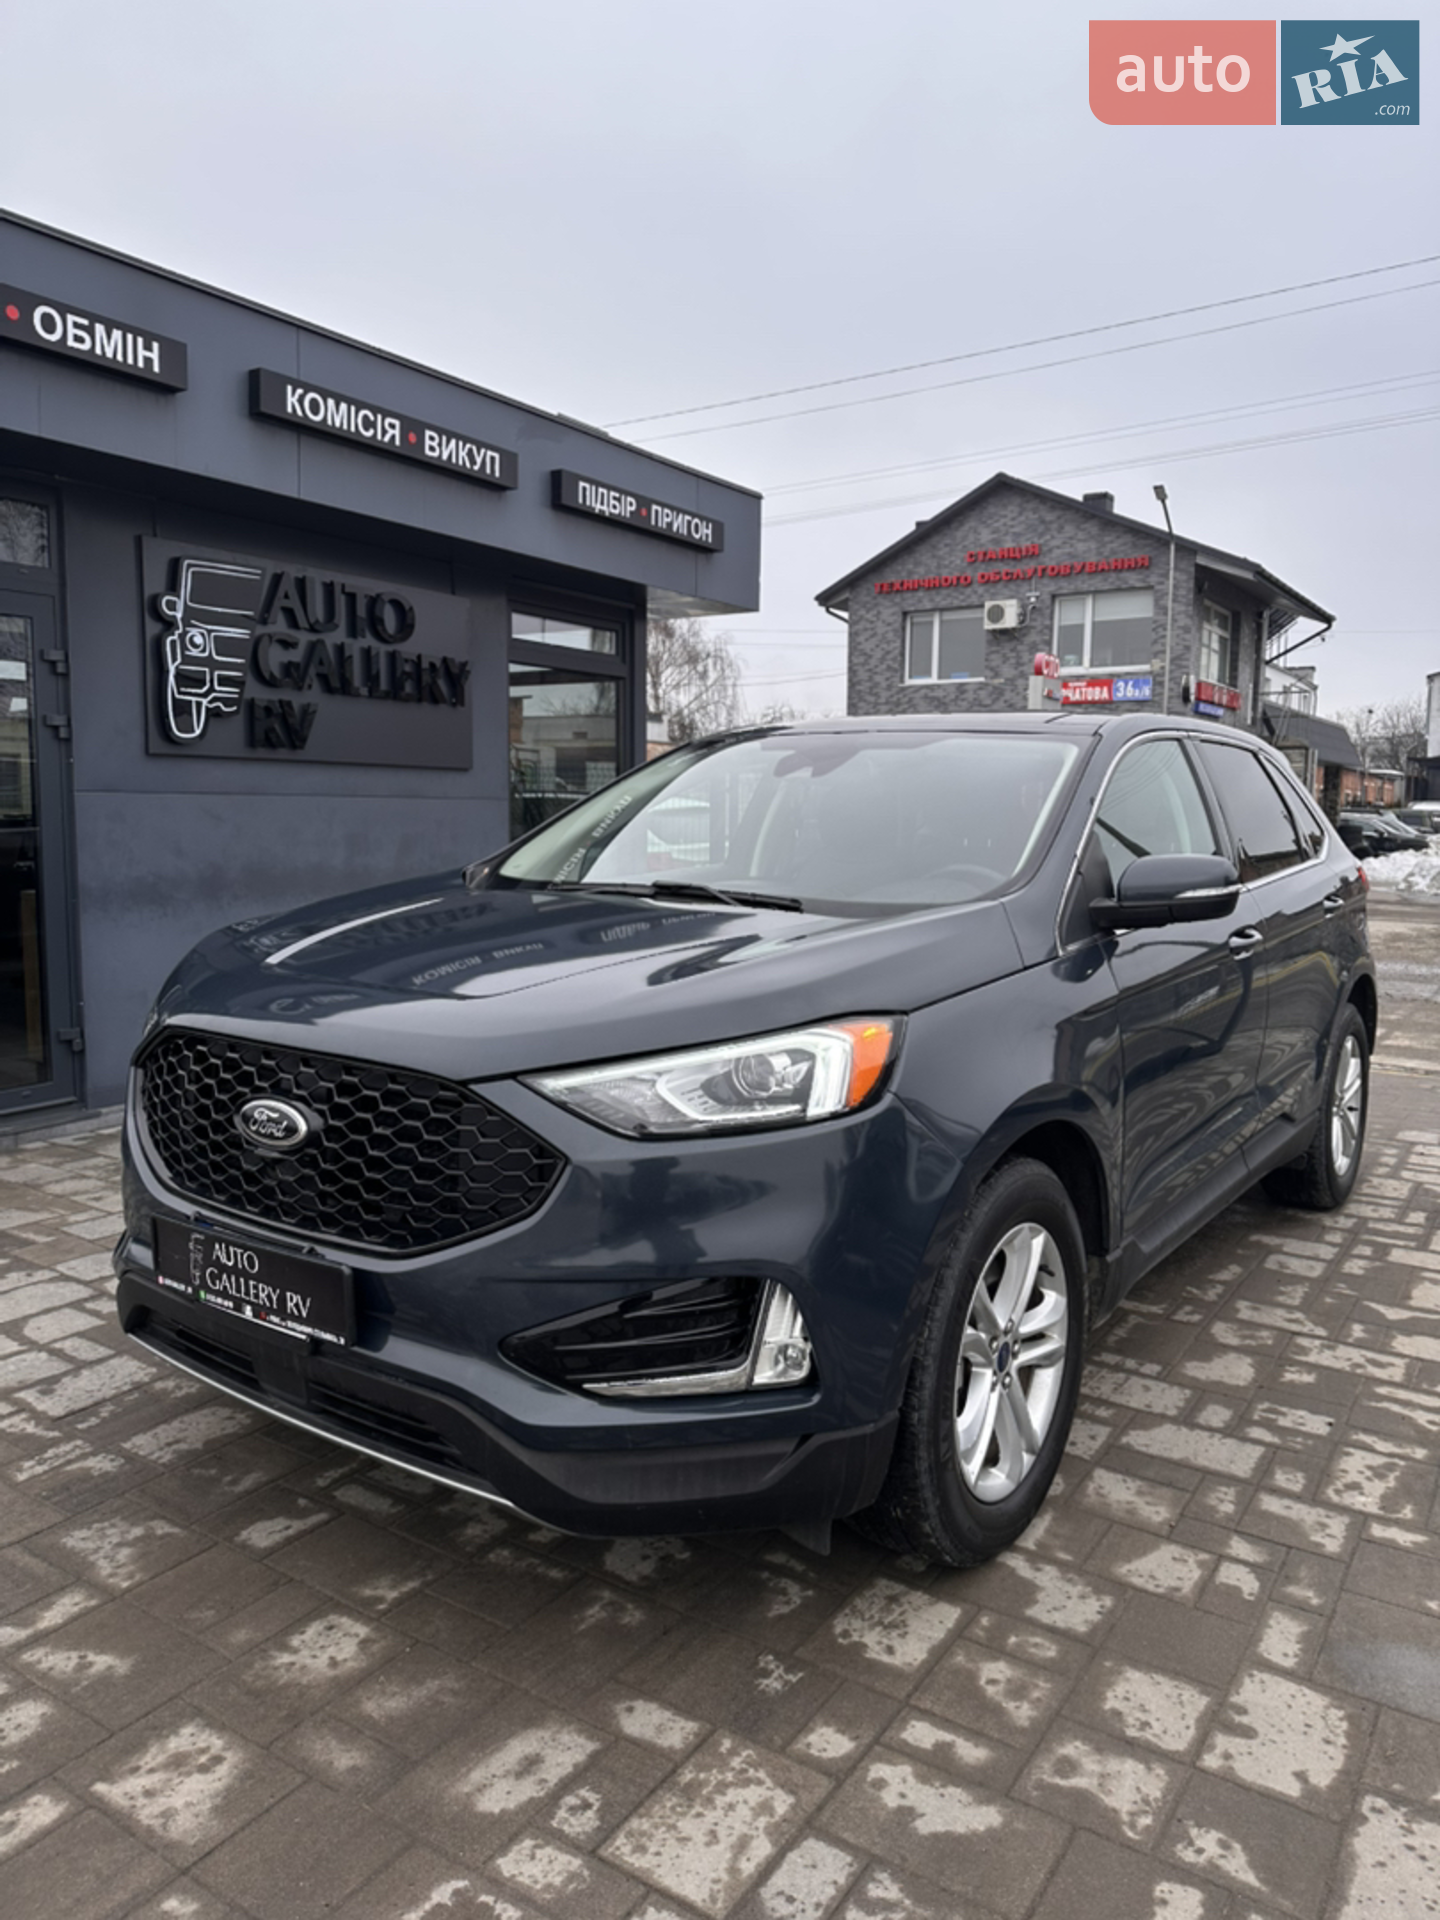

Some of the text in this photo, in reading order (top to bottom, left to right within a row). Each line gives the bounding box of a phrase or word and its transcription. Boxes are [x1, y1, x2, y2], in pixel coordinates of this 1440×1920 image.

[33, 305, 160, 373] ОБМІН
[286, 384, 500, 478] КОМІСІЯ ВИКУП
[578, 480, 712, 543] ПІДБІР ПРИГОН
[874, 554, 1150, 595] ТЕХНІЧНОГО ОБСЛУГОВУВАННЯ
[965, 544, 1039, 563] СТАНЦІЯ
[257, 571, 416, 644] AUTO
[253, 632, 471, 707] GALLERY
[248, 697, 319, 750] RV
[249, 1107, 288, 1138] Ford
[212, 1242, 259, 1273] AUTO
[205, 1267, 280, 1309] GALLERY
[286, 1291, 312, 1318] RV
